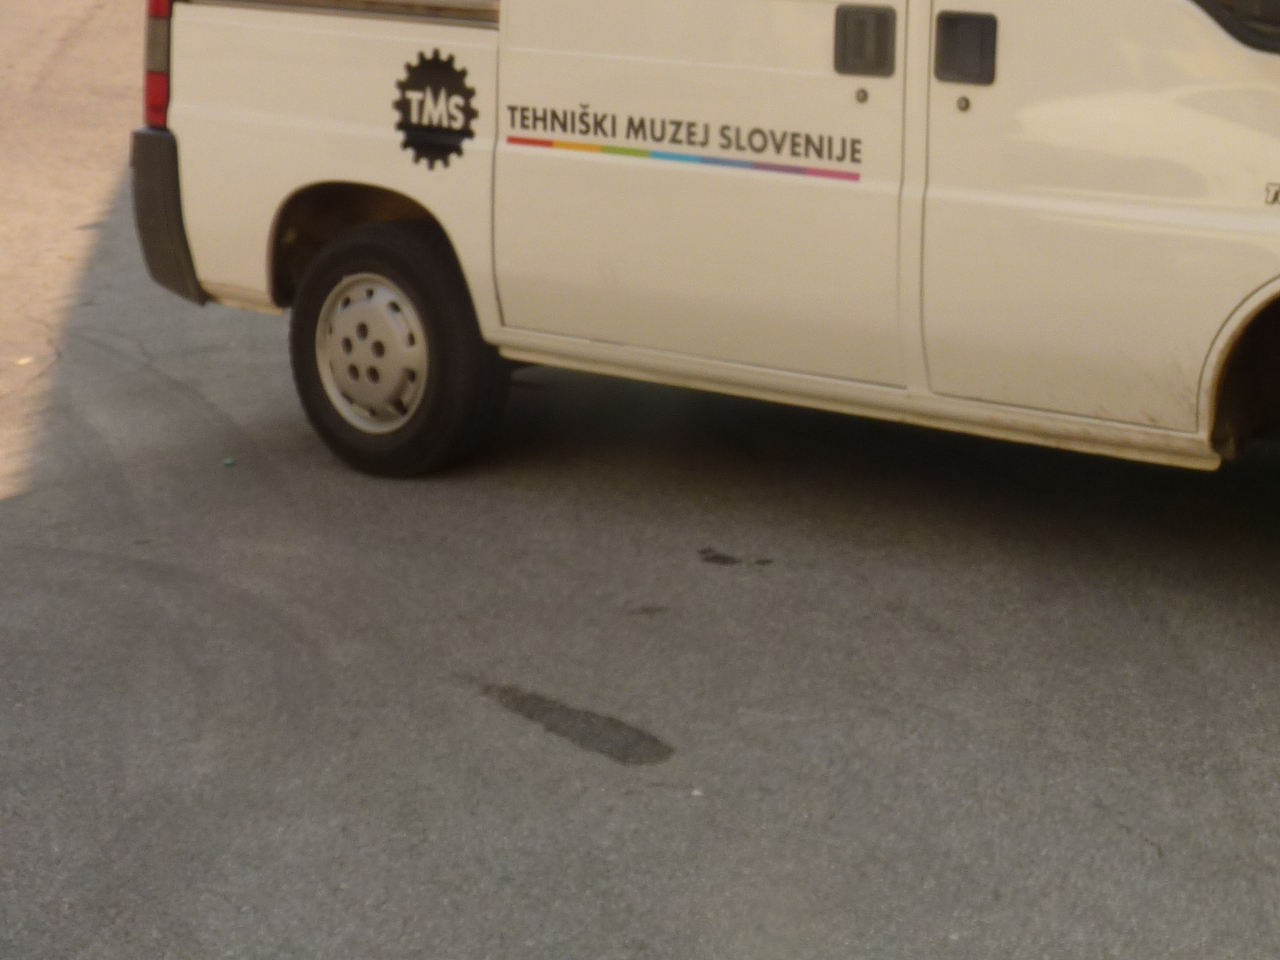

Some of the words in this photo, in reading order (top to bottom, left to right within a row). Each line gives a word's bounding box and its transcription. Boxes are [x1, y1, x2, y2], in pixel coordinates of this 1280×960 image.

[405, 86, 466, 129] TMS
[507, 103, 617, 139] TEHNIŠKI
[626, 114, 710, 148] MUZEJ
[719, 124, 863, 164] SLOVENIJE
